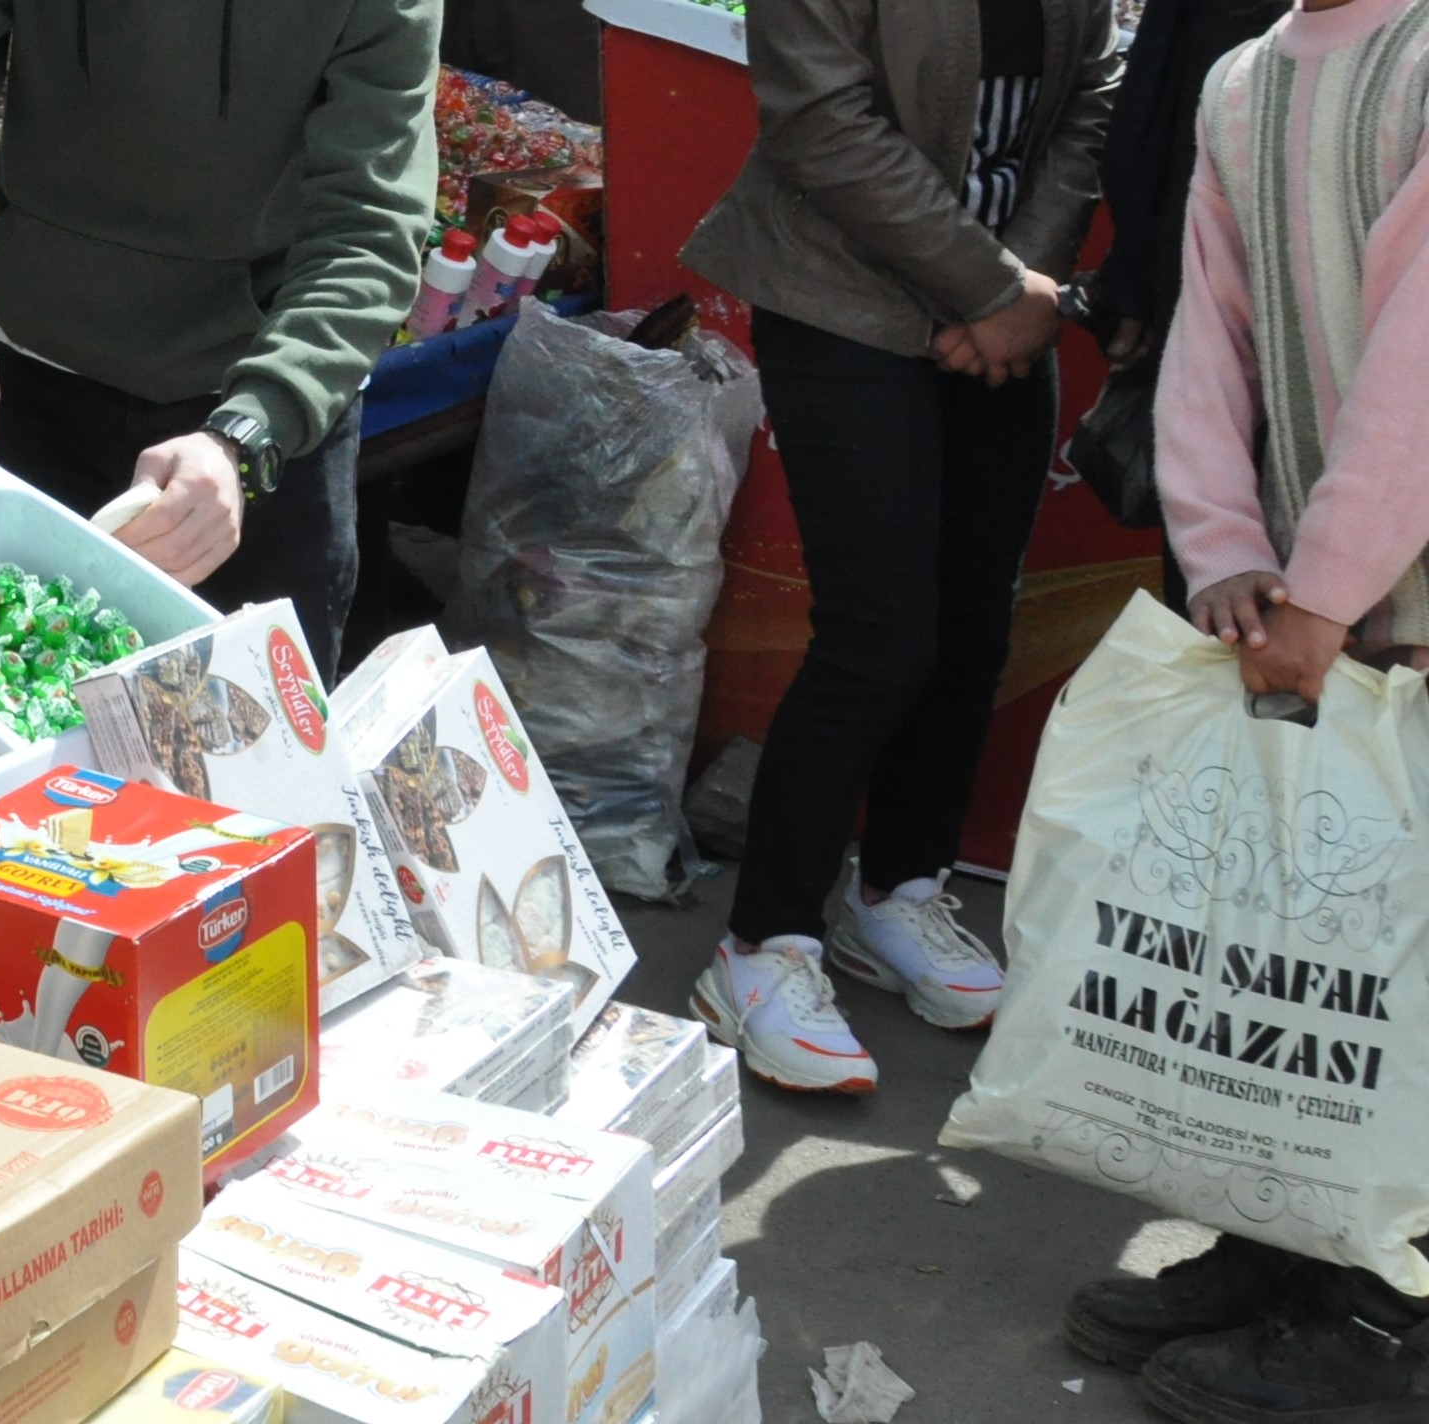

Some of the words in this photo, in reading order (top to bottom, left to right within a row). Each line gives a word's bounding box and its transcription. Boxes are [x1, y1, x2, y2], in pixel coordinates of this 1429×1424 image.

[270, 642, 316, 741] Seyyidler
[476, 696, 521, 781] Seyyidler
[53, 778, 111, 803] Türker
[201, 905, 246, 942] Türker
[1220, 942, 1391, 1022] ŞAFAK
[1067, 969, 1383, 1090] MAĞAZASI
[1072, 1029, 1167, 1078] MANİFATURA
[1179, 1061, 1283, 1109] KONFEKSİYON
[1295, 1093, 1363, 1125] ÇEYİZLİK
[1083, 1082, 1137, 1109] CENGİZ
[1139, 1100, 1181, 1124] TOPEL
[1184, 1111, 1251, 1144] CADDESİ
[1253, 1134, 1278, 1150] NO:
[1282, 1141, 1289, 1155] 1
[1293, 1142, 1332, 1161] KARS
[1134, 1112, 1164, 1130] TEL:
[1167, 1122, 1206, 1145] (0474)
[1209, 1133, 1234, 1150] 223
[1236, 1140, 1253, 1154] 17
[69, 1198, 125, 1257] TARİHİ:
